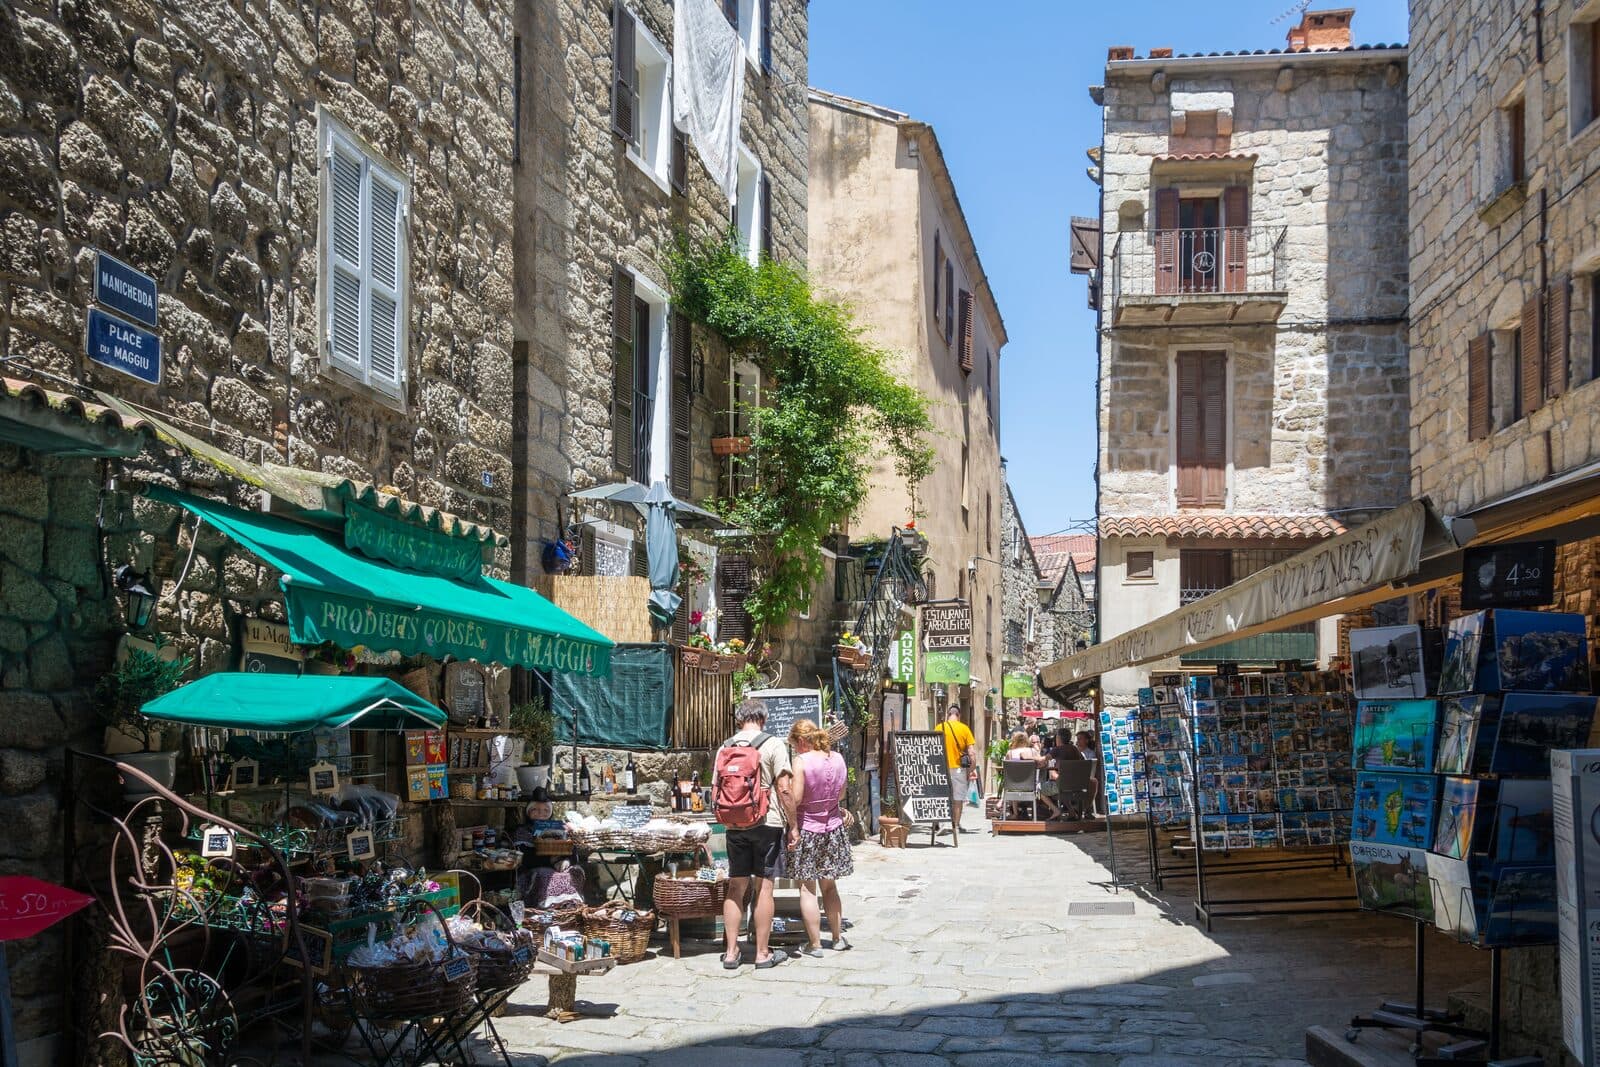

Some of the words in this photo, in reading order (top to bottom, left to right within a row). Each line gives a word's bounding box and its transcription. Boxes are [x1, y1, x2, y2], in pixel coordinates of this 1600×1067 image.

[102, 271, 153, 309] MANICHEDDA
[109, 324, 142, 349] PLACE
[100, 344, 110, 354] DU
[114, 345, 150, 370] MAGGIU
[320, 601, 419, 640] PRODUITS
[523, 632, 598, 673] MAGGIU
[895, 735, 941, 746] RESTAURANT
[896, 754, 930, 766] CUISINE
[898, 764, 941, 776] FAMILIALE
[899, 774, 948, 786] SPECIALITES
[900, 785, 925, 796] CORSE
[913, 799, 950, 810] TERRASSE
[1353, 845, 1393, 859] CORSICA
